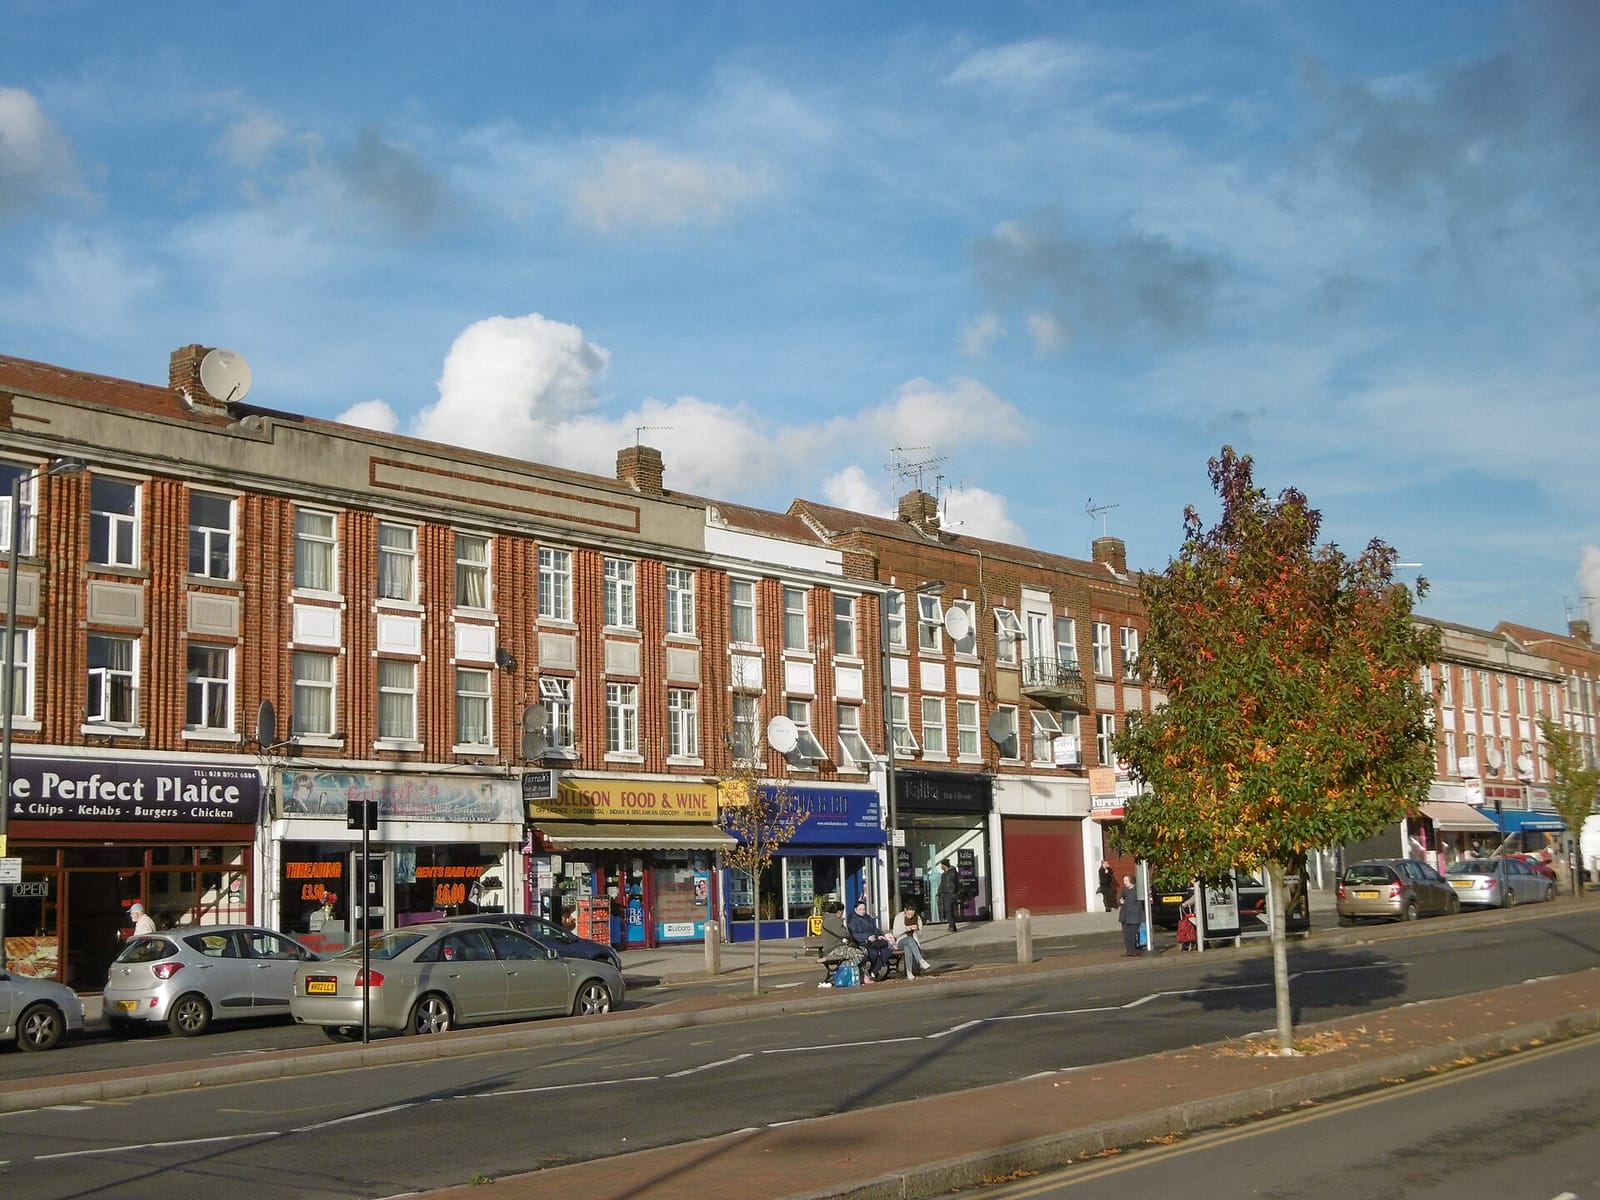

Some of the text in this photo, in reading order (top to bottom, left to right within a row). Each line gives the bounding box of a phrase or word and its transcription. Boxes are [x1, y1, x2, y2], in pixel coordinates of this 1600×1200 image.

[42, 772, 144, 801] Perfect
[156, 777, 240, 804] Plaice
[620, 791, 656, 808] FOOD
[661, 792, 672, 808] &
[676, 793, 708, 809] WINE
[28, 803, 64, 816] Chips
[78, 805, 121, 816] Kebabs
[134, 806, 178, 819] Burgers
[190, 807, 233, 818] Chicken
[286, 862, 342, 878] THREADING
[13, 882, 48, 896] OPEN
[436, 883, 466, 904] £6.00
